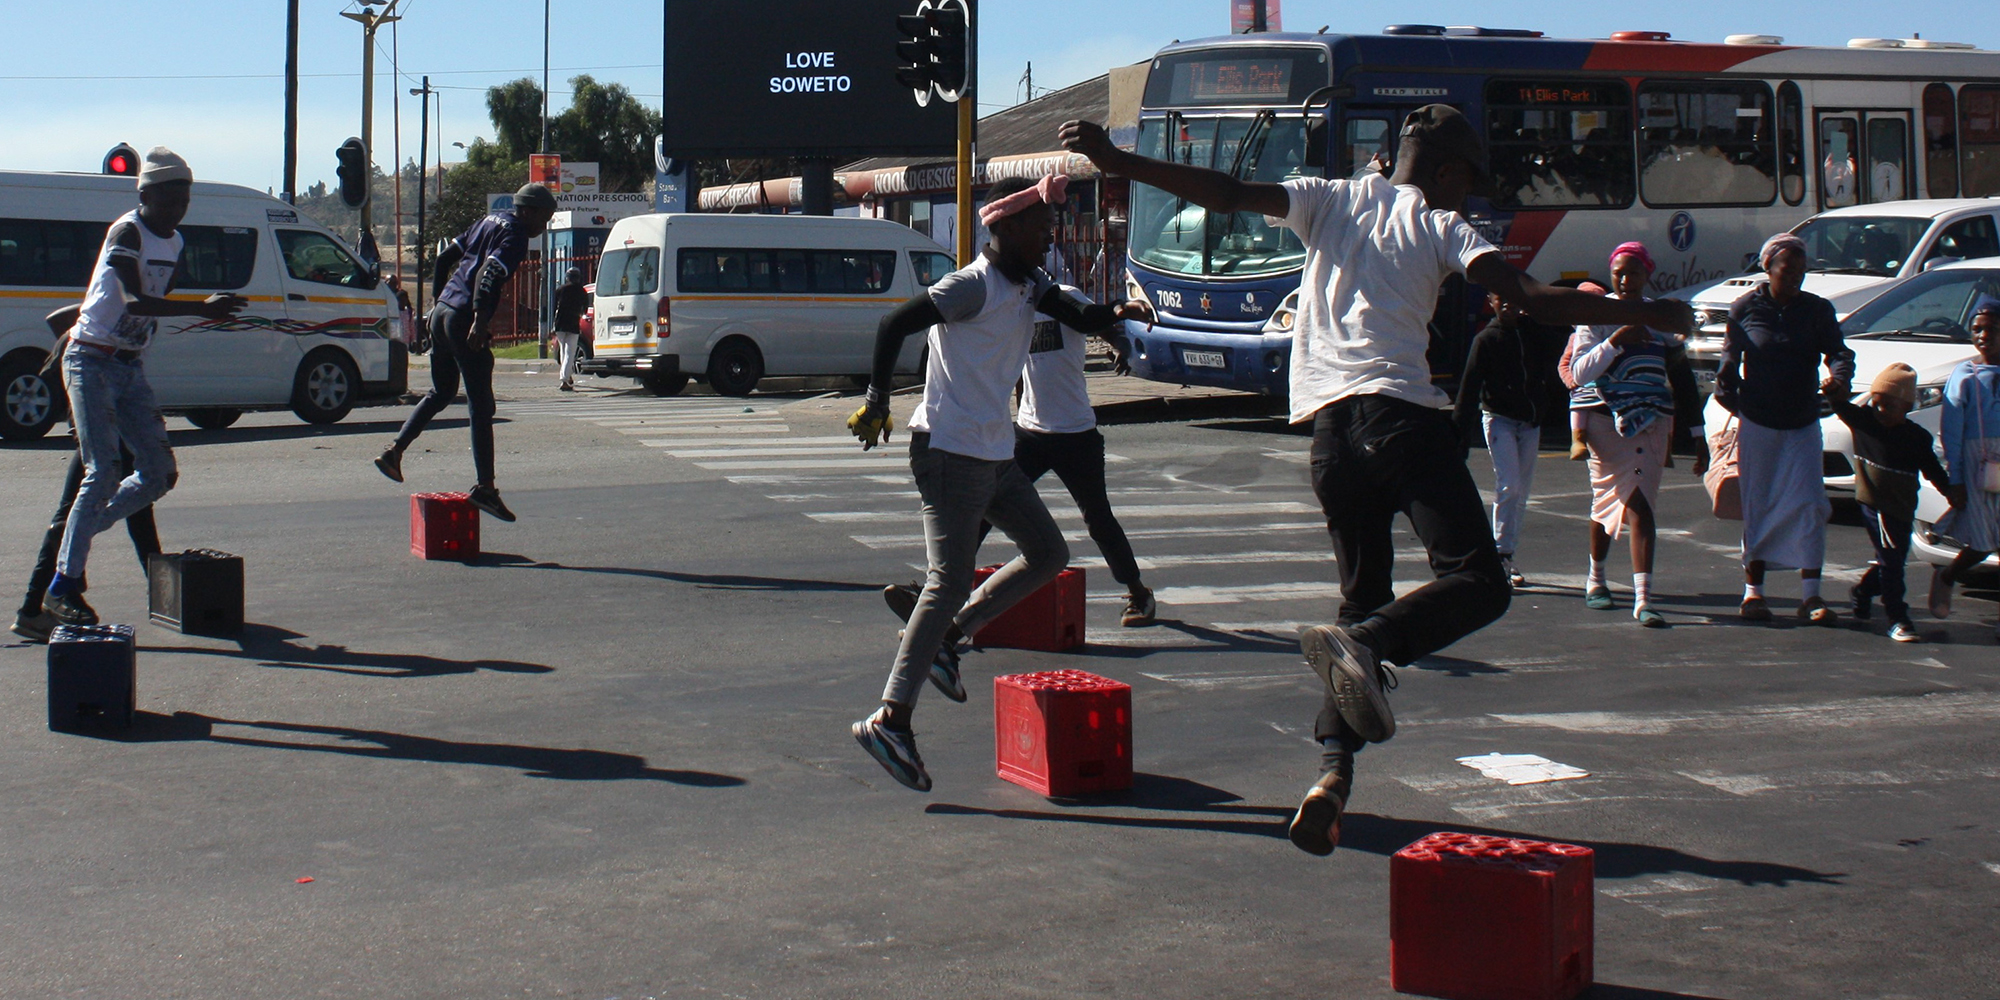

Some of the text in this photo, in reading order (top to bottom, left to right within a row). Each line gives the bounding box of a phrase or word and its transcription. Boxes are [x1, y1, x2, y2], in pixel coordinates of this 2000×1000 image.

[786, 52, 835, 69] LOVE
[769, 75, 851, 94] SOWETO
[1216, 66, 1243, 94] Ellis
[1248, 64, 1283, 93] Park
[1535, 88, 1559, 102] Ellis
[1562, 88, 1590, 102] Park
[873, 165, 957, 195] NOORDGESIG
[592, 194, 649, 203] PRE-SCHOOL
[700, 185, 760, 210] BUTCHERY
[1156, 290, 1183, 308] 7062
[1198, 354, 1211, 365] 633
